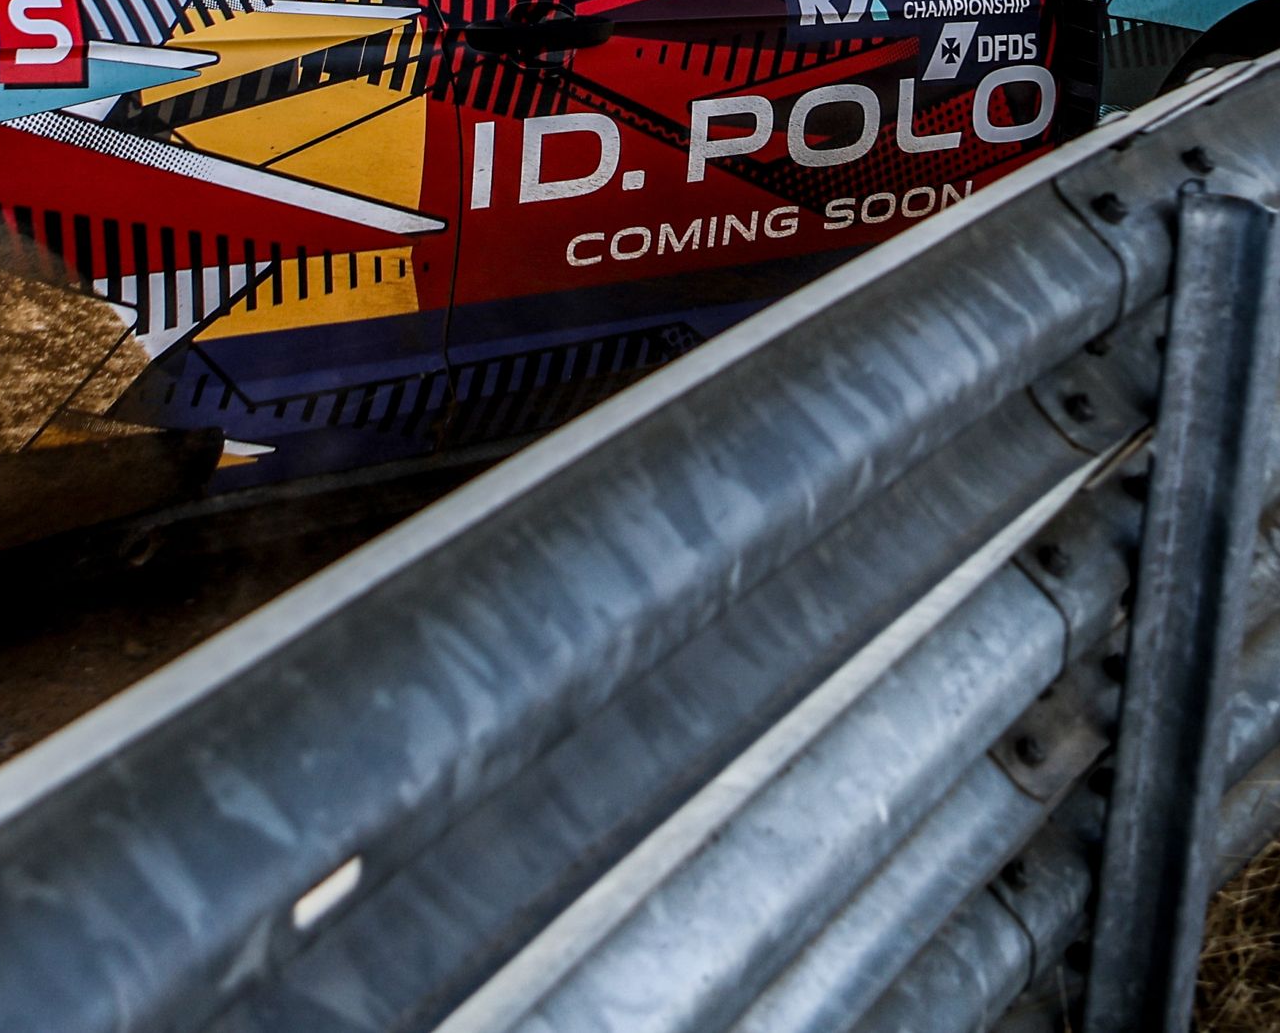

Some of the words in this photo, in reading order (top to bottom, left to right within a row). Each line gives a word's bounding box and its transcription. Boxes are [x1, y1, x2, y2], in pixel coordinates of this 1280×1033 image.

[978, 32, 1038, 63] DFDS
[470, 112, 646, 211] ID.
[686, 64, 1057, 184] POLO
[566, 205, 800, 267] COMING
